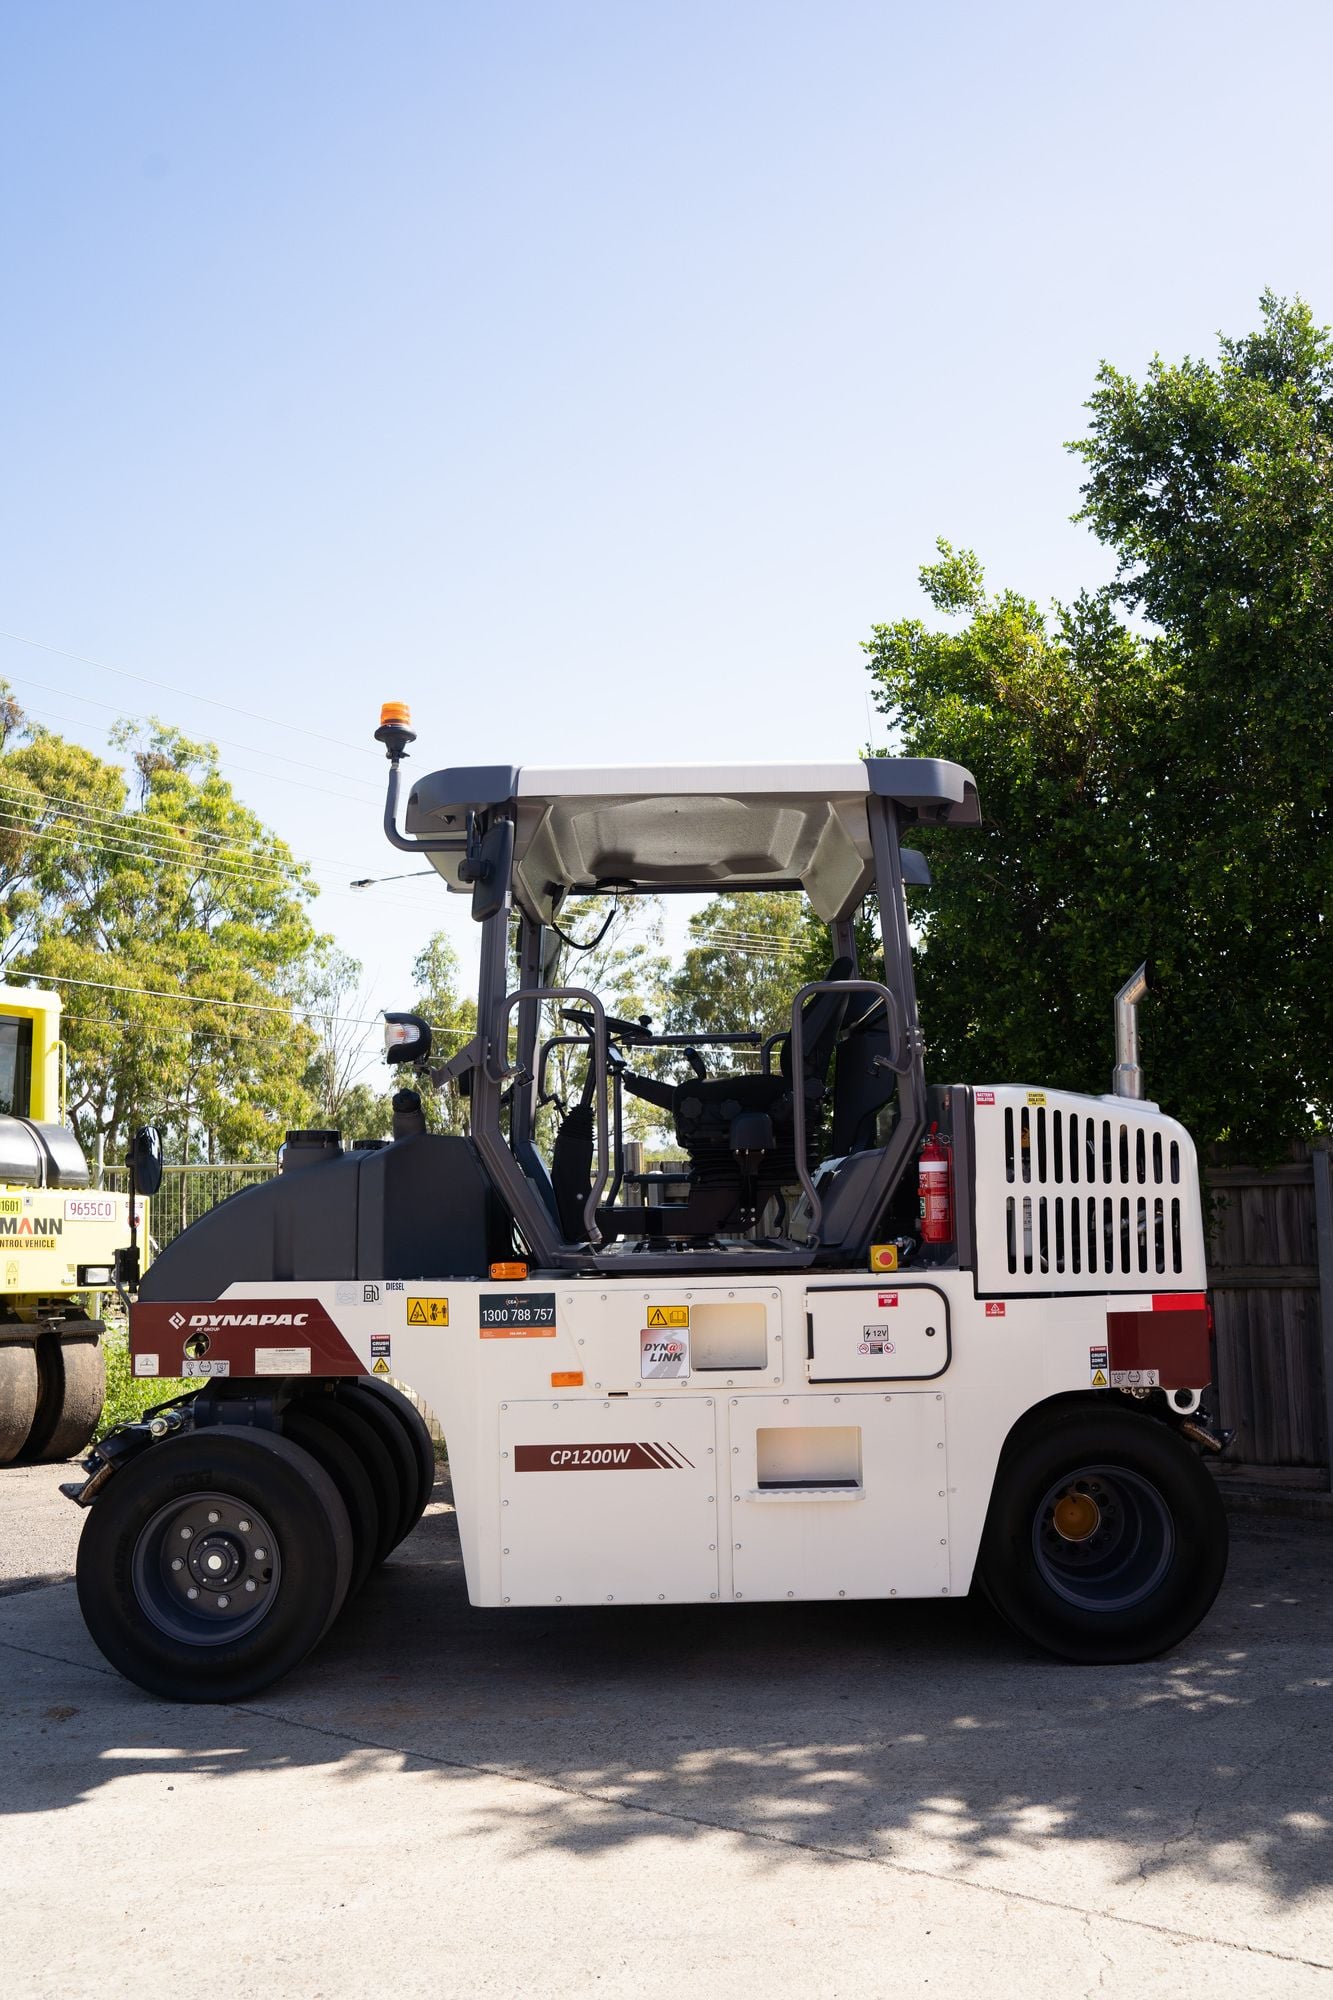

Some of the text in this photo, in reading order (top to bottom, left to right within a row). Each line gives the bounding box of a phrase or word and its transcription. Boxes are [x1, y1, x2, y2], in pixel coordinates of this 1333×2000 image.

[0, 1200, 19, 1211] 1601
[0, 1217, 63, 1234] MANN
[25, 1239, 55, 1248] VEHICLE
[385, 1282, 405, 1290] DIESEL
[188, 1313, 309, 1327] DYNAPAC
[482, 1308, 553, 1322] 1300 788 757
[873, 1329, 887, 1337] 12V
[650, 1352, 682, 1362] LINK
[550, 1448, 631, 1465] CP1200W
